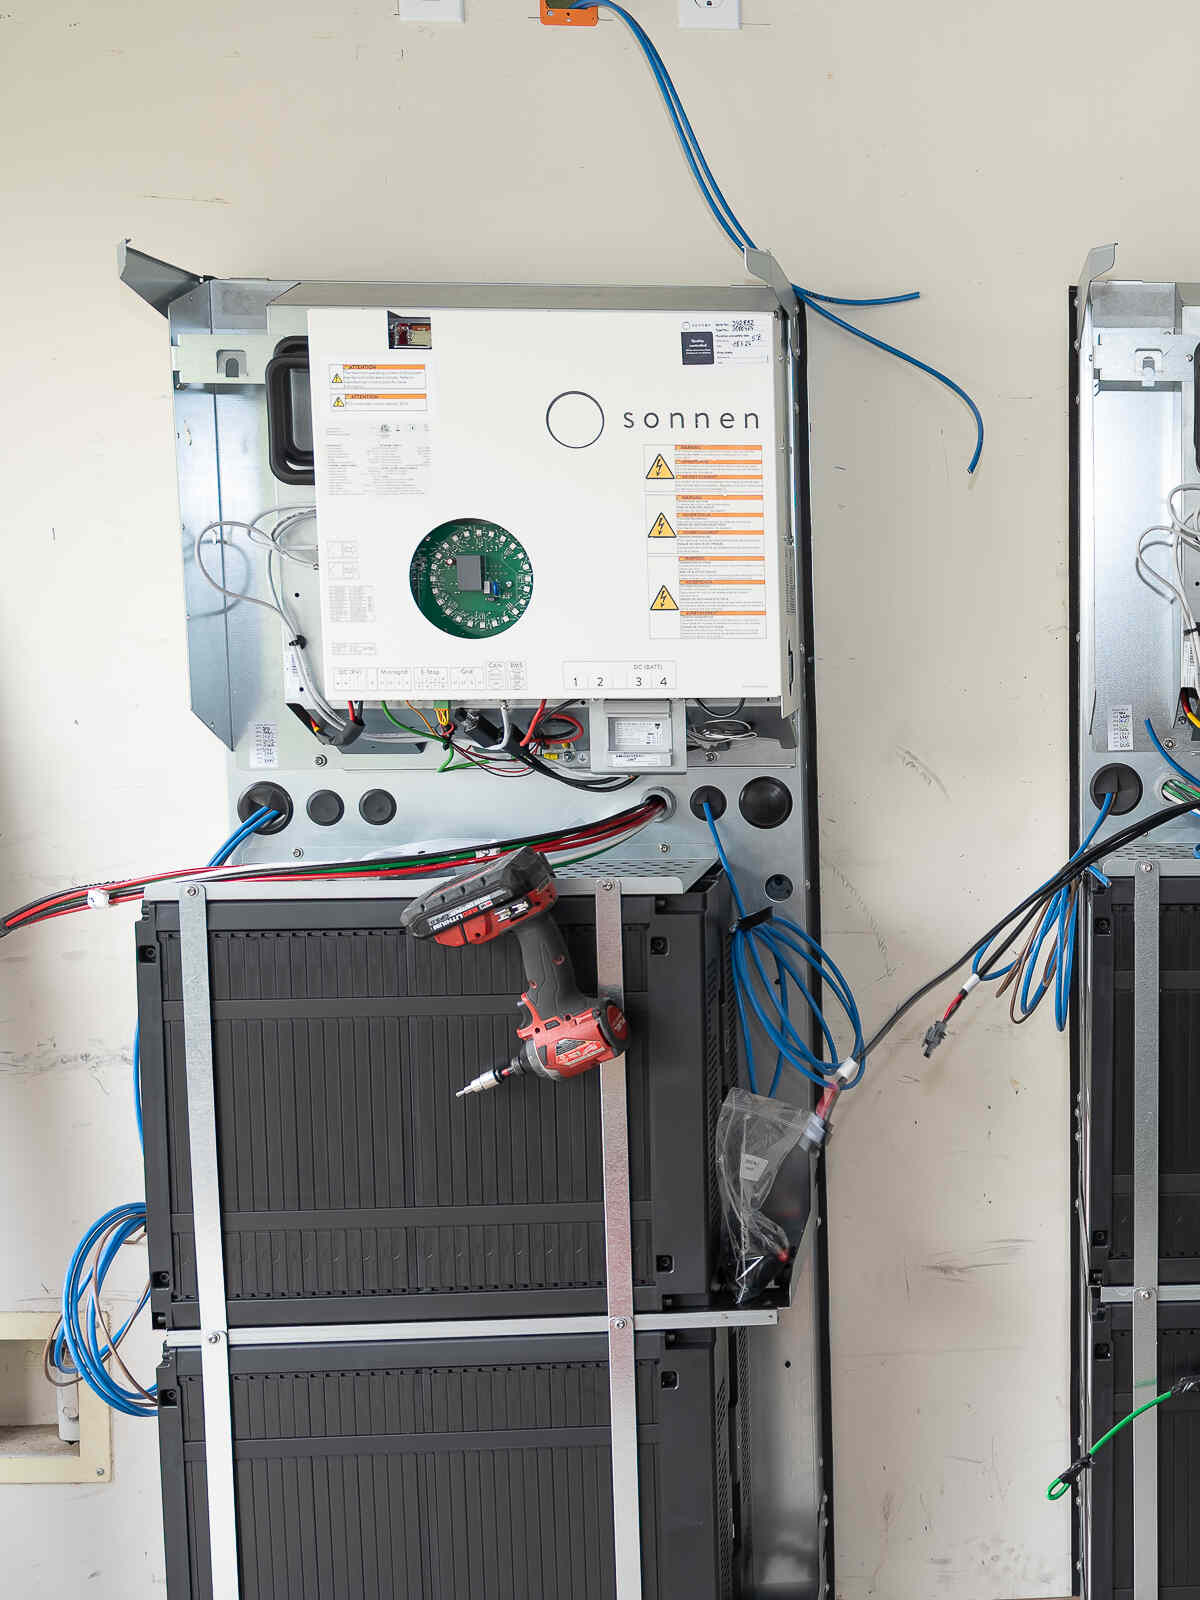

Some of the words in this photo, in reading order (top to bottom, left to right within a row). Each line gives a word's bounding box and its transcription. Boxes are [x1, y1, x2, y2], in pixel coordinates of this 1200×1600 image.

[623, 411, 759, 429] sonnen
[573, 677, 578, 687] 1
[596, 677, 604, 687] 2
[635, 677, 643, 687] 3
[660, 677, 668, 686] 4
